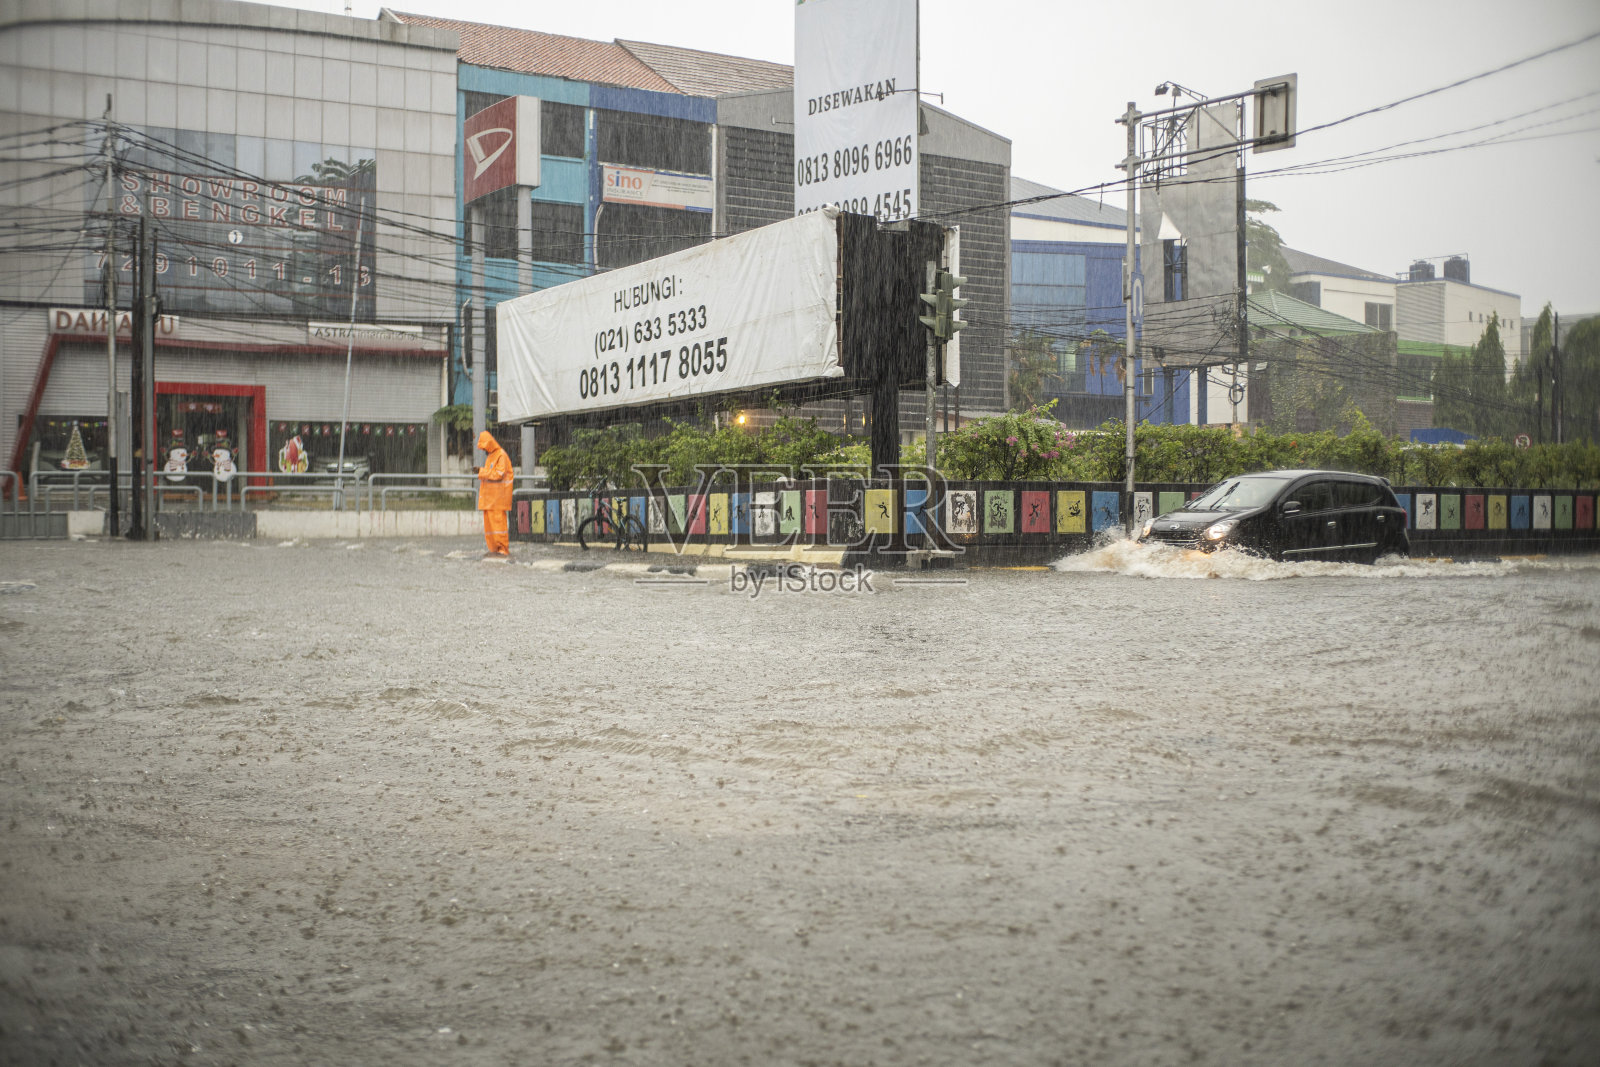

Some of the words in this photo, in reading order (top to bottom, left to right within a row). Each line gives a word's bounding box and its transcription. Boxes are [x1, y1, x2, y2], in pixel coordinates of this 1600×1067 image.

[808, 77, 896, 116] DISEWAKAN
[797, 153, 829, 187] 0813
[834, 144, 869, 179] 8096
[875, 134, 912, 170] 6966
[121, 170, 347, 208] SHOWROOM
[606, 170, 643, 190] sino
[873, 188, 911, 222] 4545
[314, 327, 355, 338] ASTRA
[594, 325, 629, 360] (021)
[634, 316, 662, 344] 633
[668, 304, 707, 337] 5333
[579, 361, 620, 400] 0813
[626, 349, 672, 390] 1117
[678, 336, 728, 379] 8055
